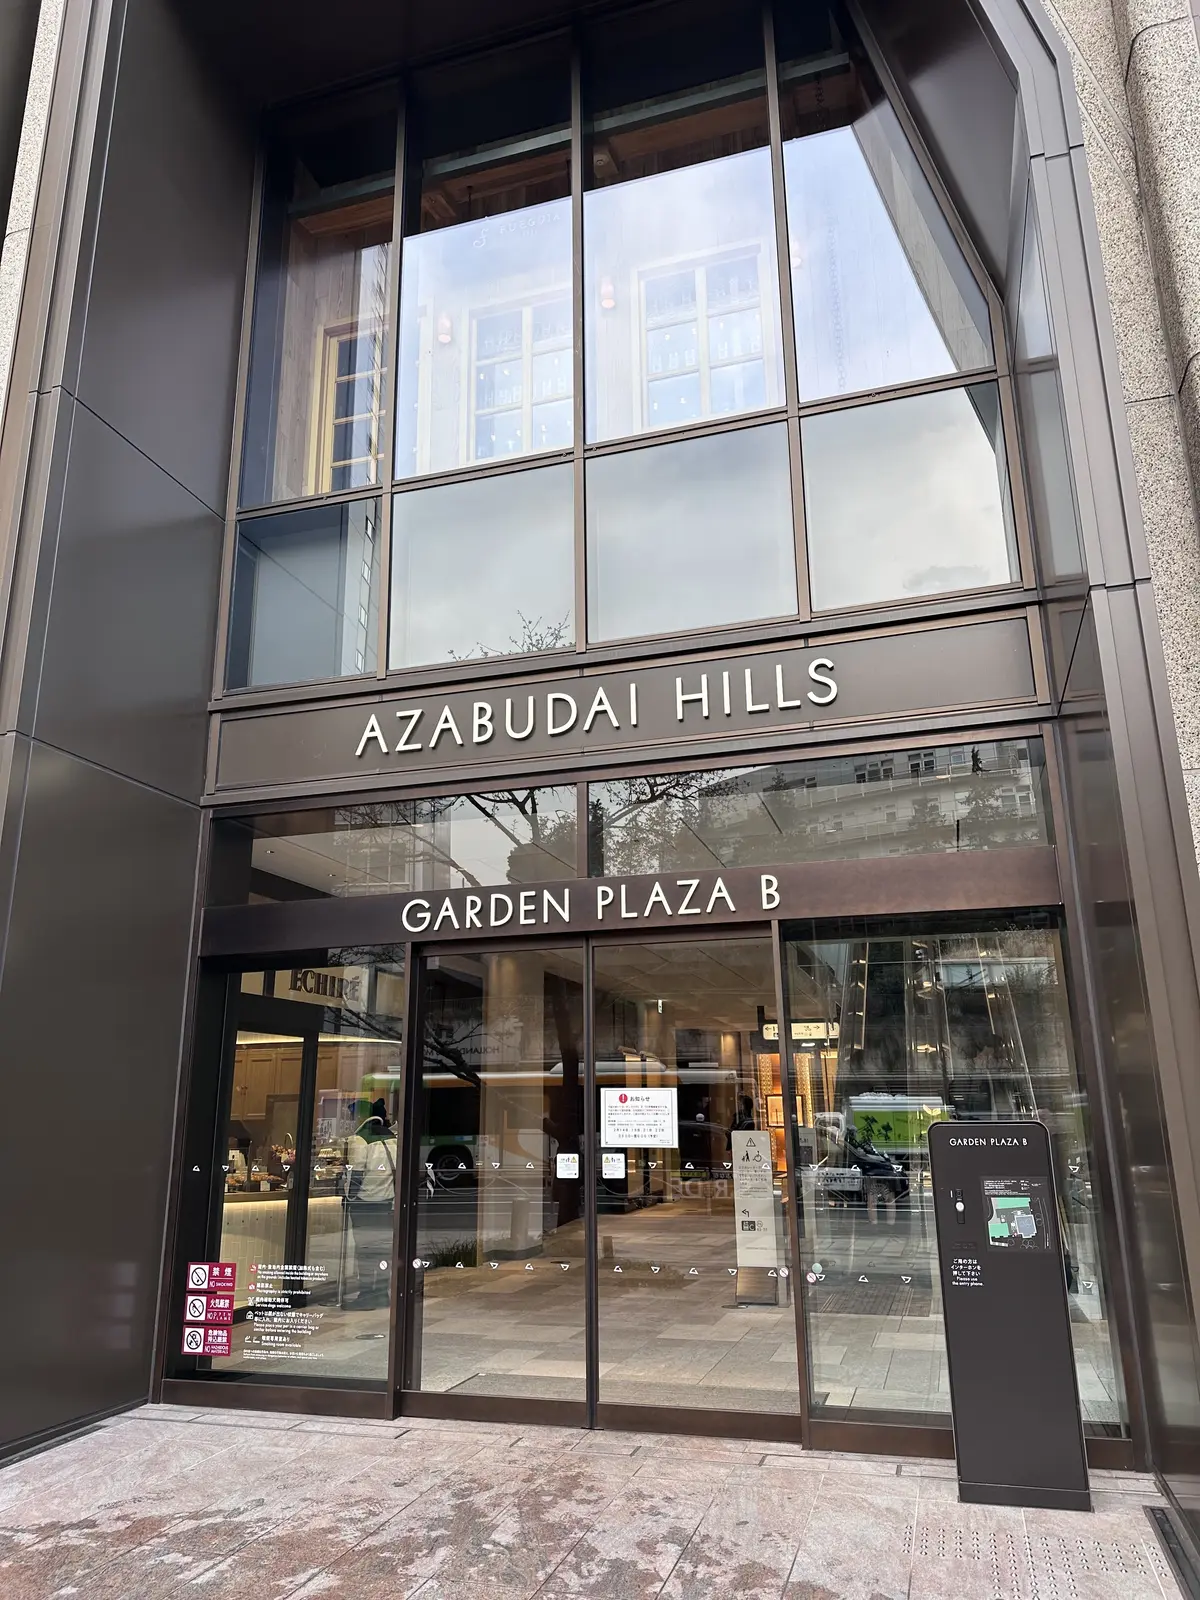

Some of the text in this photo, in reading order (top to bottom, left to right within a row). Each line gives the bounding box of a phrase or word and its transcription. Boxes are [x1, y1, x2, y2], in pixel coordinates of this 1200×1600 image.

[355, 658, 838, 757] AZABUDAI HILLS
[402, 874, 781, 933] GARDEN PLAZA B
[949, 1138, 1028, 1146] GARDEN PLAZA B
[209, 1280, 215, 1288] NO
